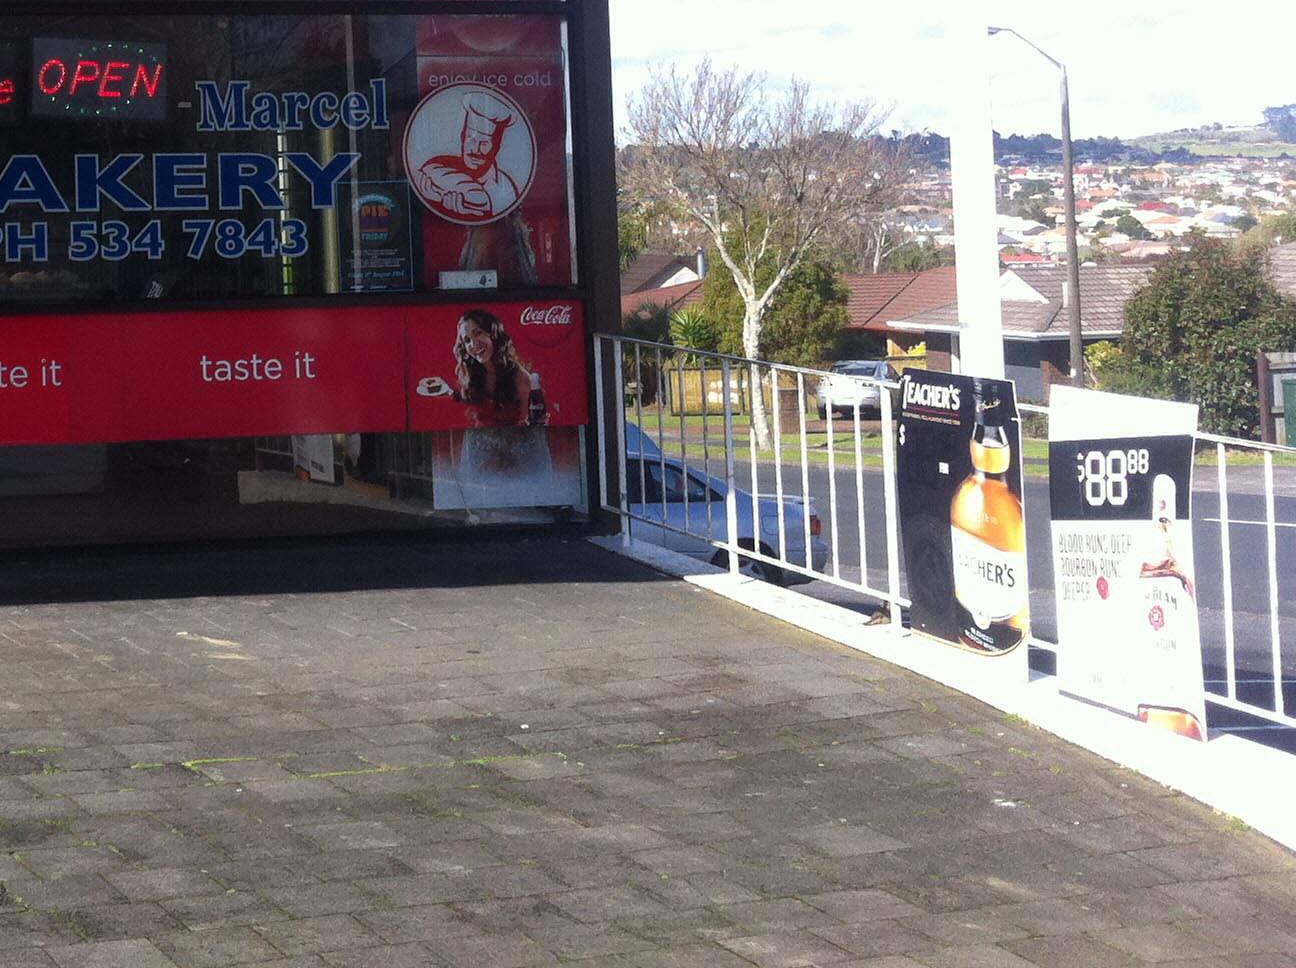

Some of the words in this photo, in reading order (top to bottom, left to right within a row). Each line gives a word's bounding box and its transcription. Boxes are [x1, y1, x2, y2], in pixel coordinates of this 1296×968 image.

[37, 58, 164, 99] OPEN
[513, 71, 553, 88] cold
[195, 78, 390, 132] Marcel
[68, 218, 165, 262] 534
[182, 217, 310, 261] 7843
[519, 304, 573, 327] Coca-Cola
[40, 358, 63, 388] it
[199, 353, 283, 383] taste
[294, 350, 316, 380] it
[901, 374, 962, 411] TEACHER'S
